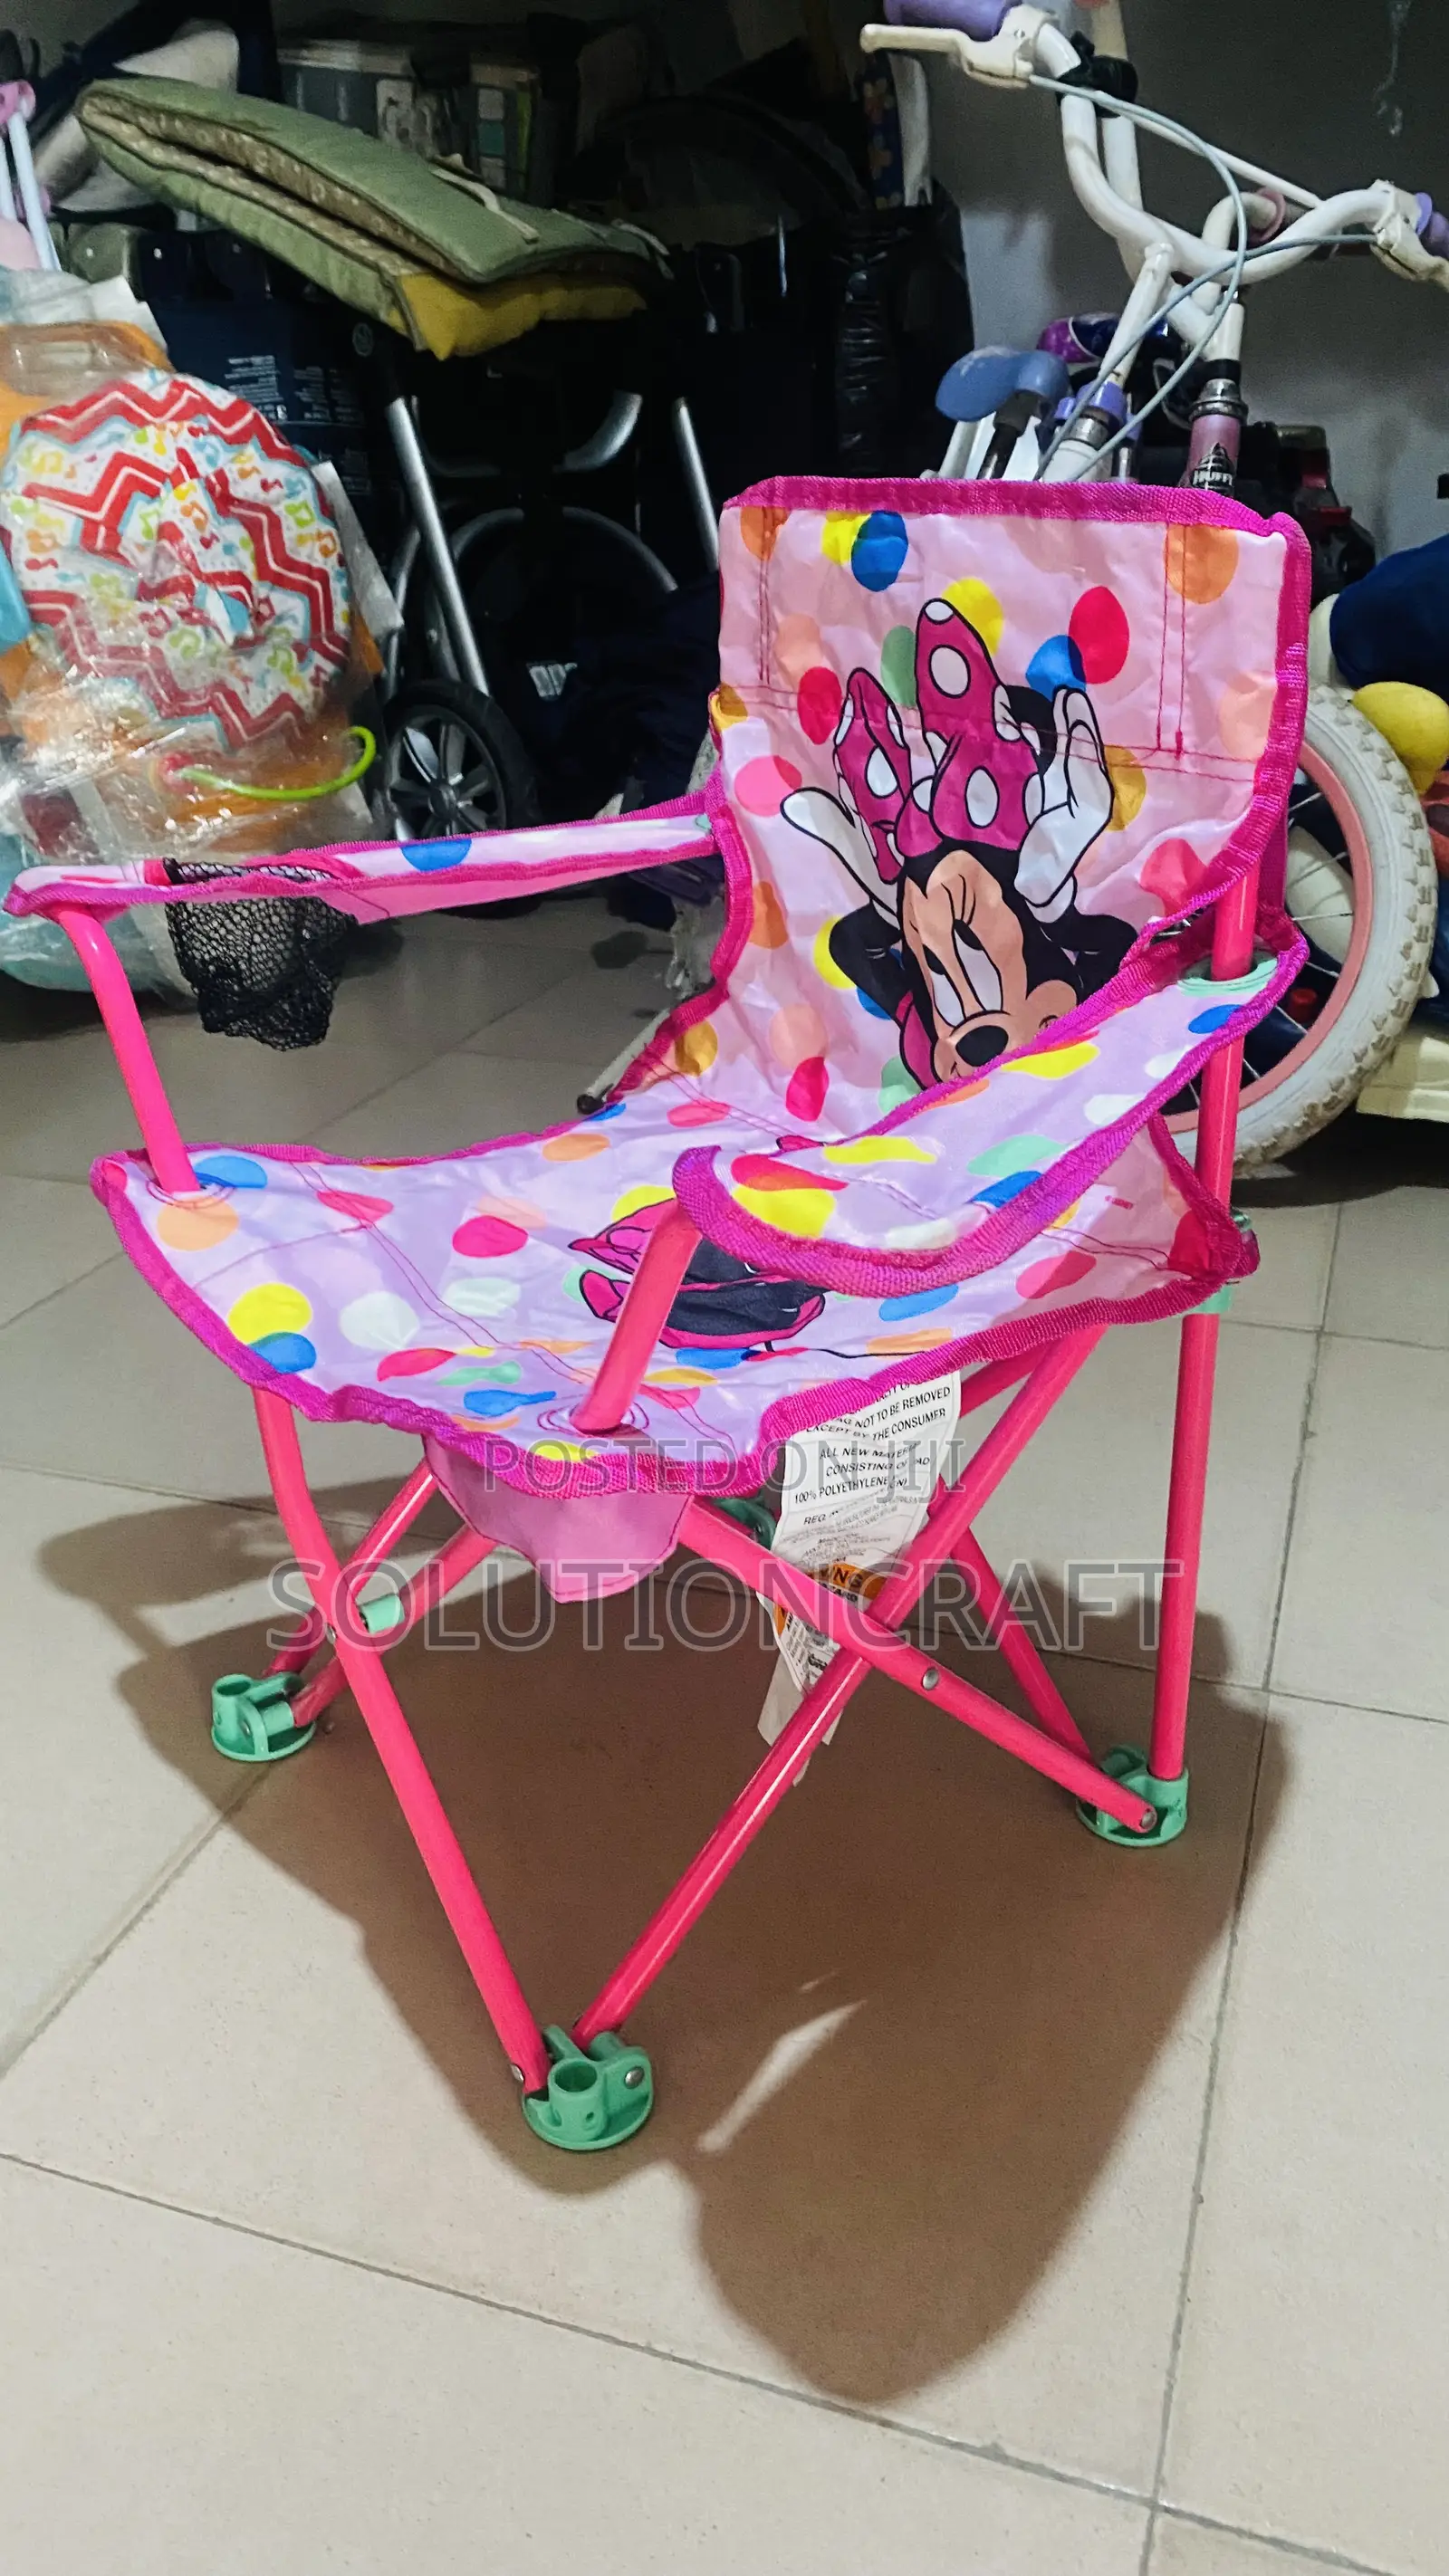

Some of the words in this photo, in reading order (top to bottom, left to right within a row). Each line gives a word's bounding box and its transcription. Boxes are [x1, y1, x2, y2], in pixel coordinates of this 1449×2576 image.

[854, 1414, 875, 1429] NOT
[877, 1408, 888, 1422] TO
[889, 1402, 900, 1416] BE
[903, 1386, 951, 1411] REMOVED
[872, 1427, 889, 1441] THE
[891, 1407, 945, 1435] CONSUMER
[820, 1447, 839, 1460] ALL
[842, 1447, 869, 1456] NEW
[826, 1461, 894, 1478] CONSISTING
[795, 1490, 817, 1505] 100%
[819, 1476, 888, 1498] POLYETHYLENE
